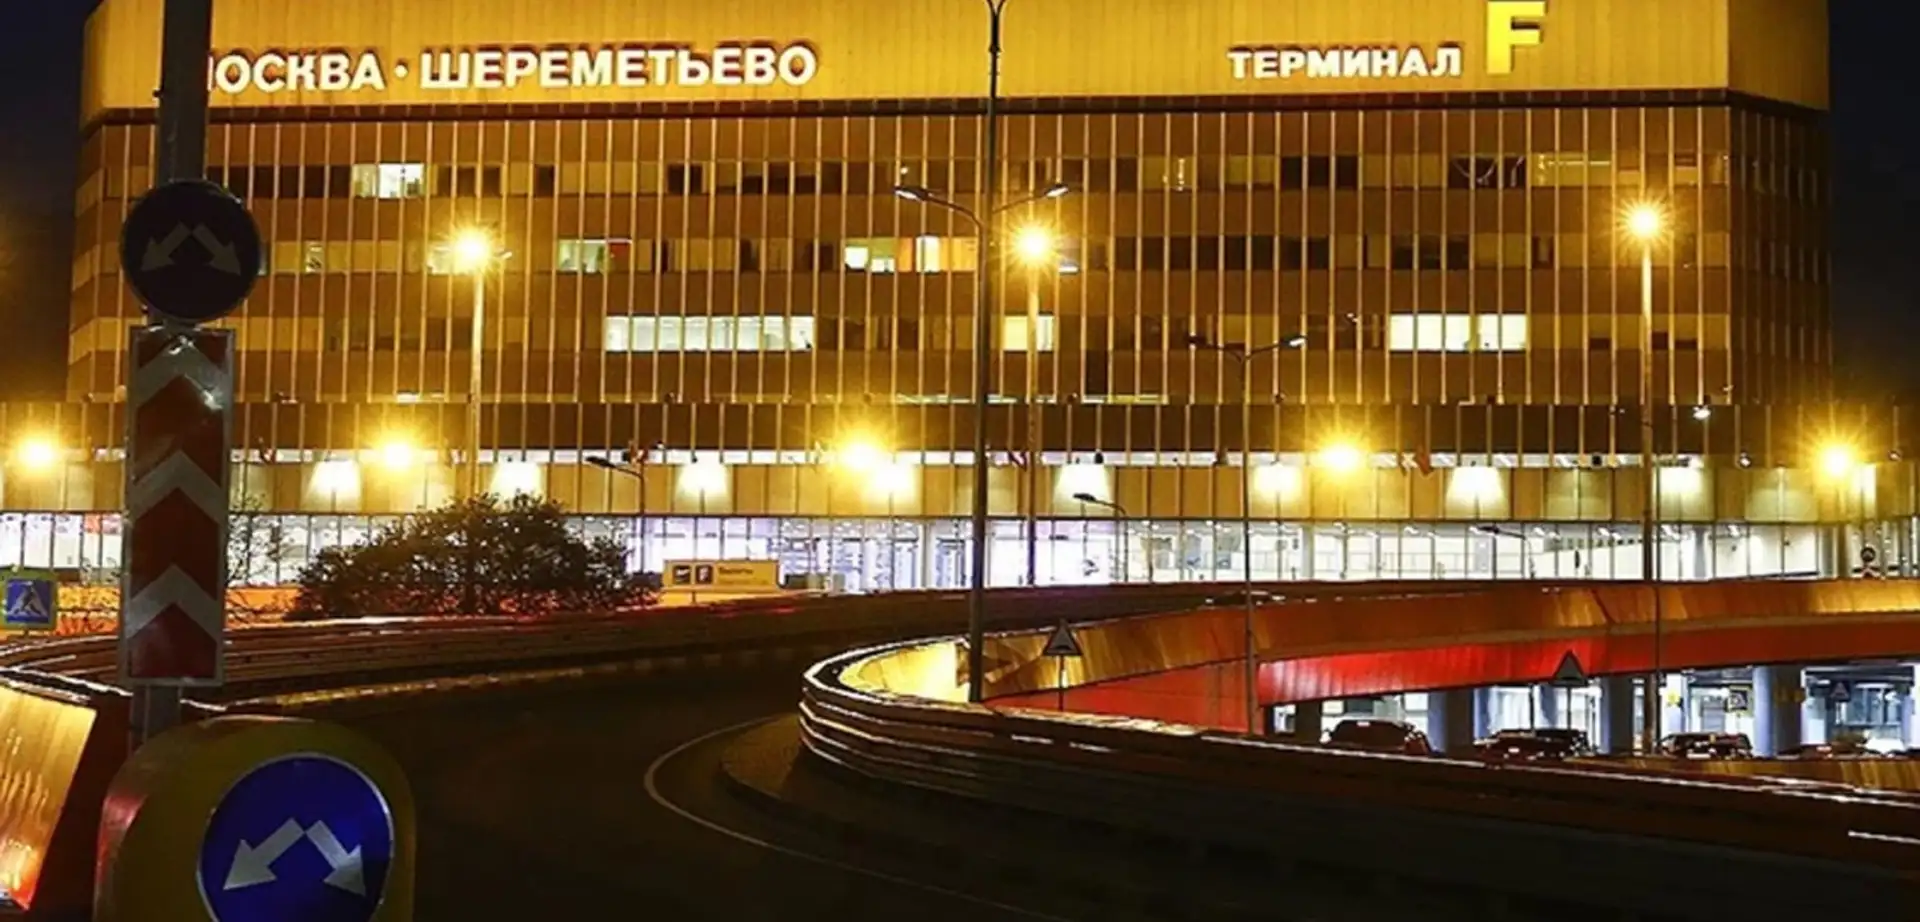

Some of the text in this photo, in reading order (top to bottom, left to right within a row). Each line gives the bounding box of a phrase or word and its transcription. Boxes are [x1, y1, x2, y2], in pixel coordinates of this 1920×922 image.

[207, 45, 817, 93] ОСКВА ШЕРЕМЕТЬЕВО
[1227, 1, 1546, 79] ТЕРМИНАЛ F
